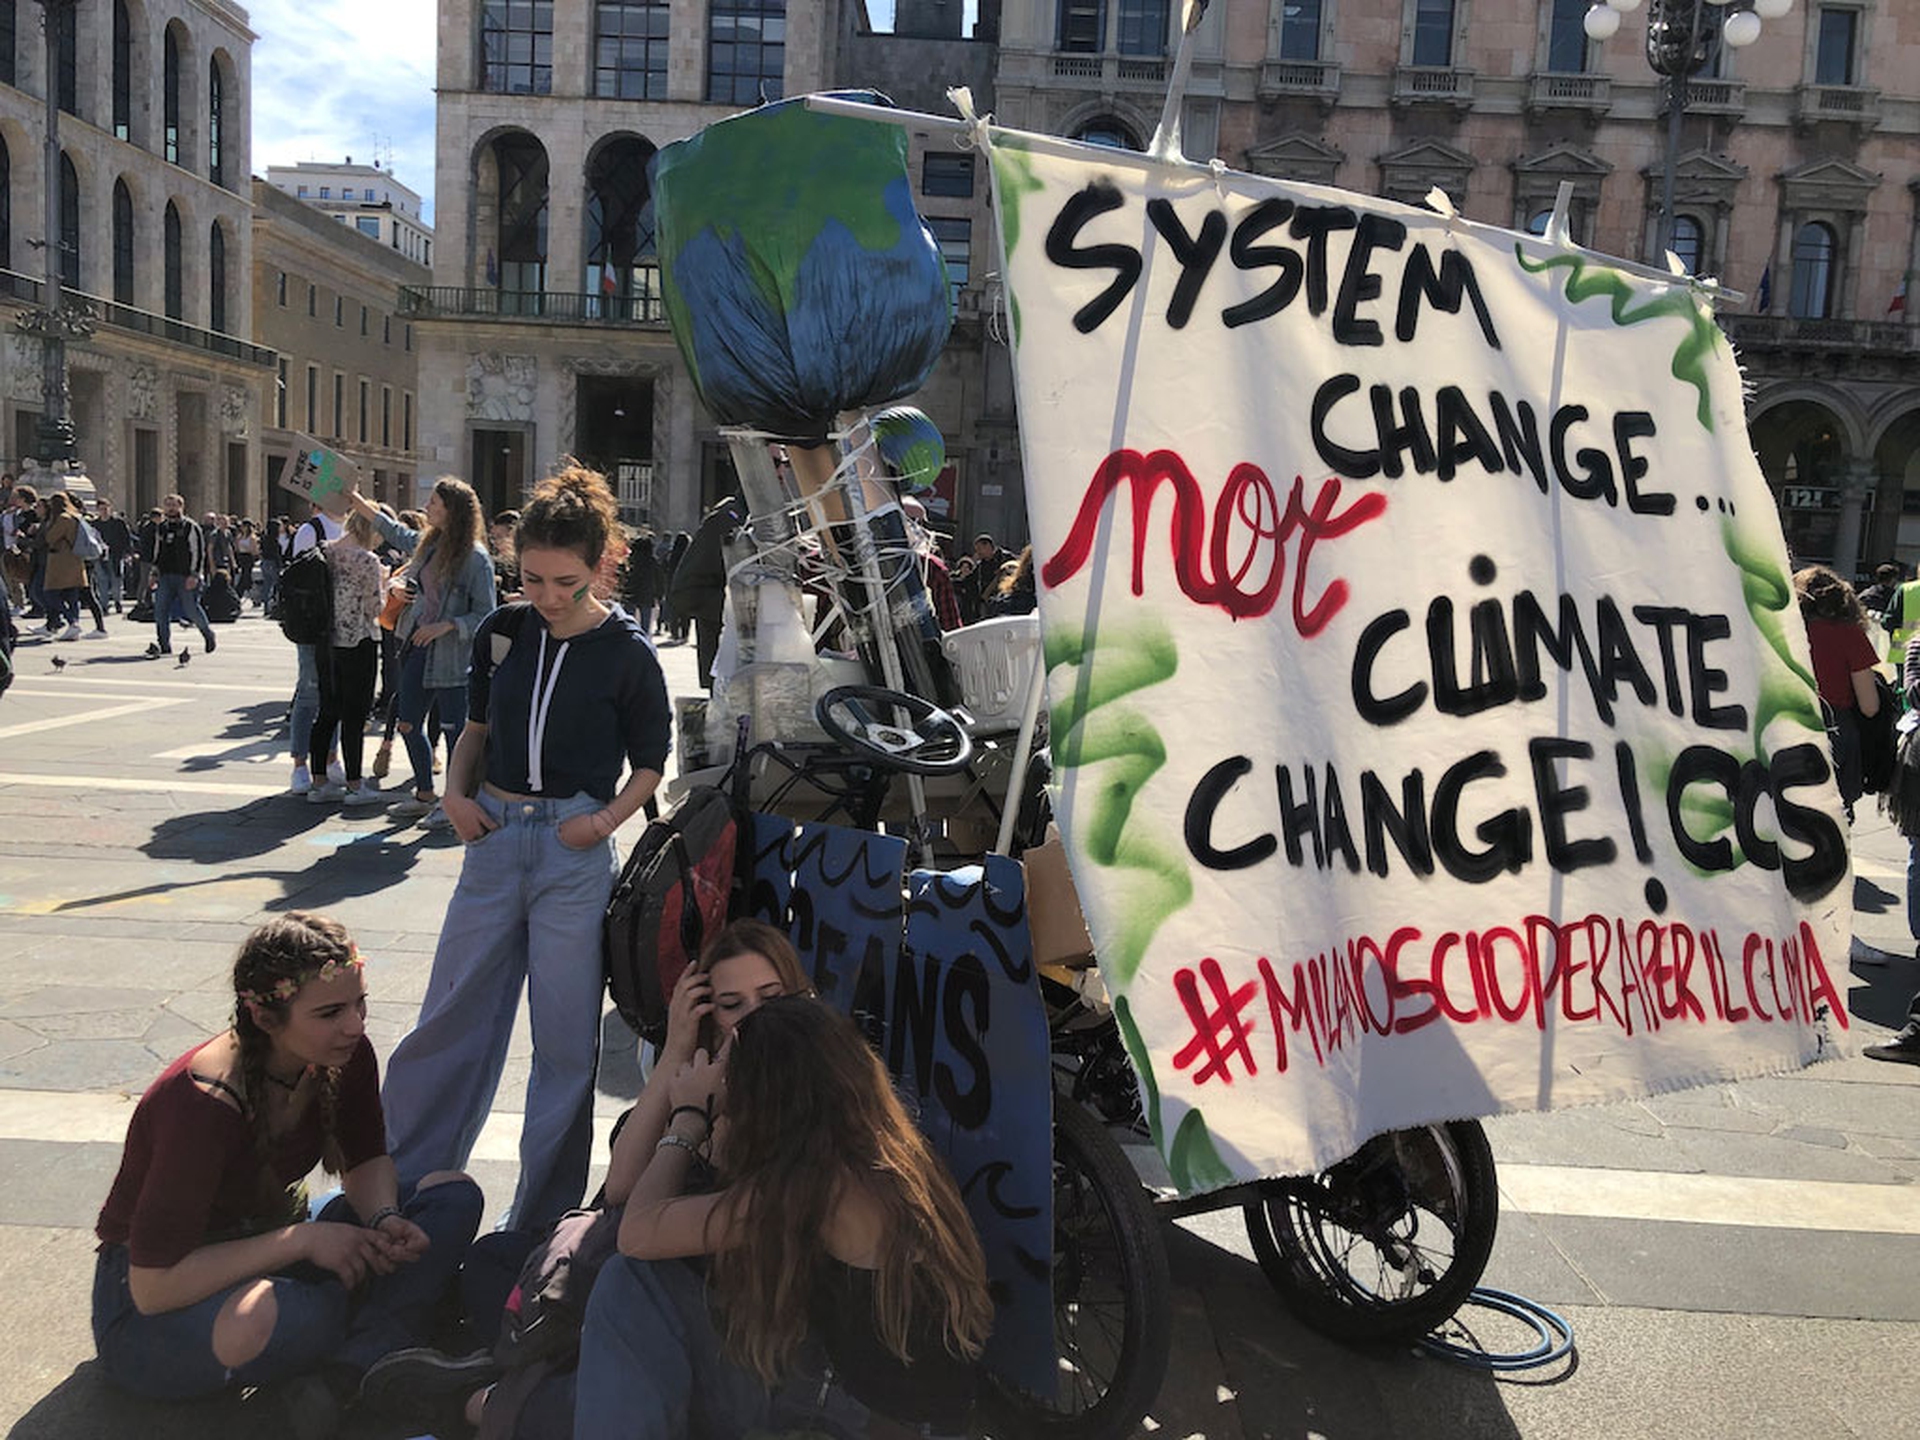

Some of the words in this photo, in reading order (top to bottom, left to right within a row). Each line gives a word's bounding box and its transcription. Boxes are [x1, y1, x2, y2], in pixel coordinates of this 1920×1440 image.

[1046, 178, 1500, 349] SYSTEM
[1352, 553, 1747, 731] CLIMATE
[1185, 737, 1667, 914] CHANGE!
